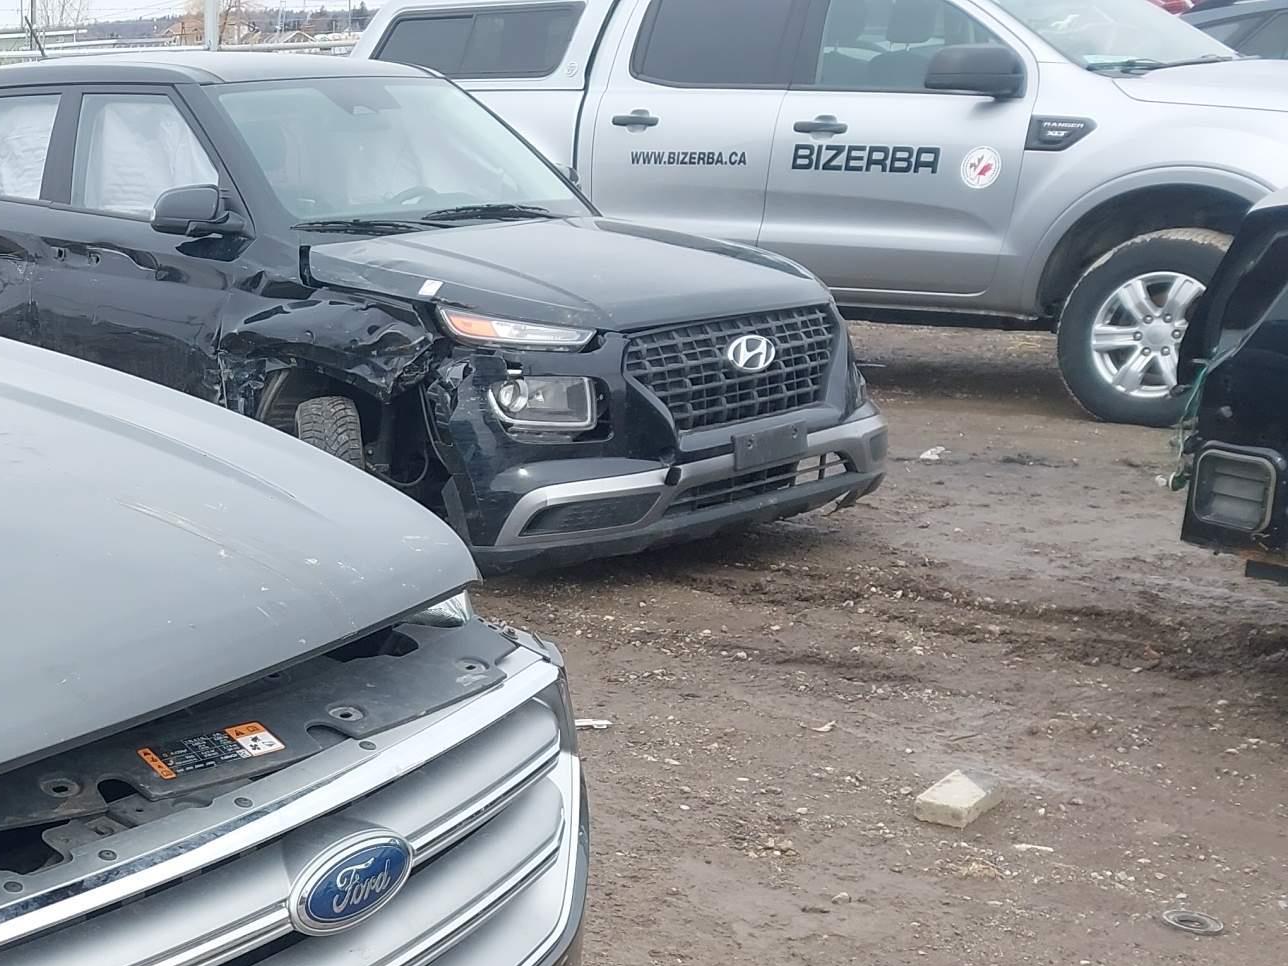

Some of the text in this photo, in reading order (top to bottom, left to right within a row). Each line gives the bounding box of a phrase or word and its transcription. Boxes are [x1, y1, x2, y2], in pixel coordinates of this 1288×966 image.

[630, 151, 748, 166] WWW.BIZERBA.CA
[791, 143, 941, 174] BIZERBA
[332, 857, 392, 914] Ford
